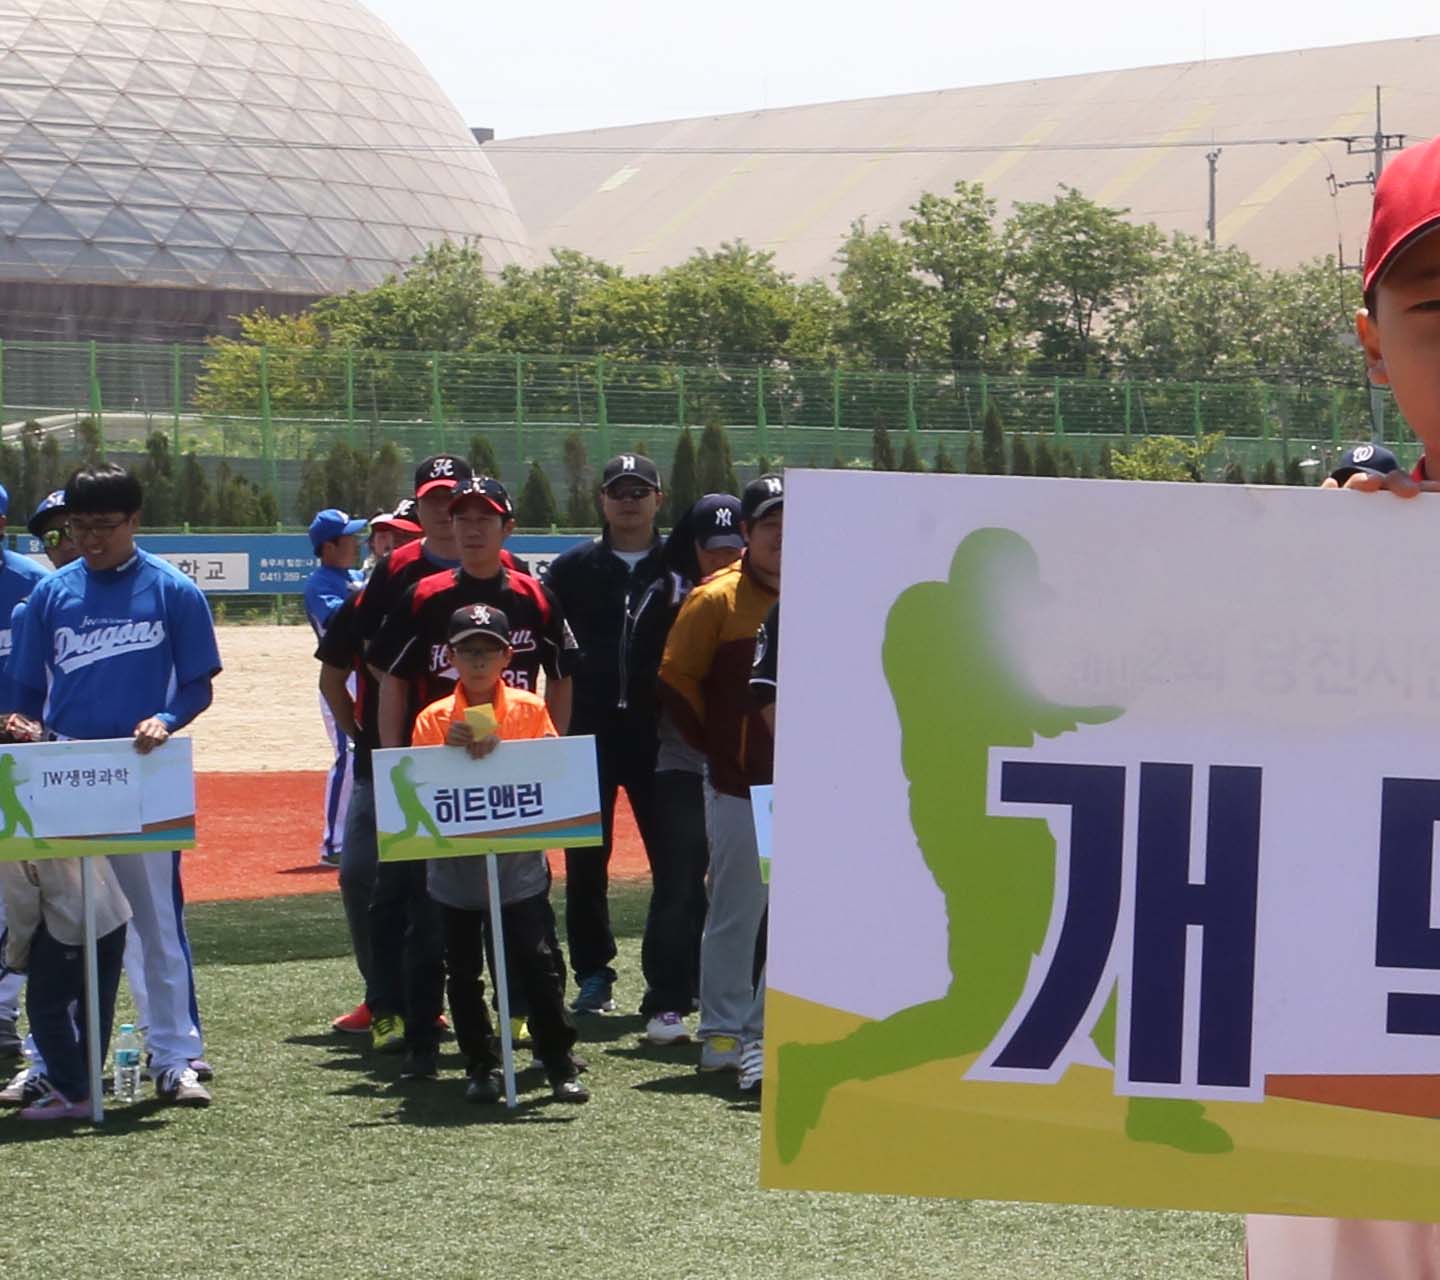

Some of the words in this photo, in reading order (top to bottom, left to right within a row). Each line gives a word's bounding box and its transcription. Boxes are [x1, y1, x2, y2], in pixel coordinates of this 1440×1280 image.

[54, 621, 165, 666] Dragons
[42, 767, 129, 788] JW생명과학
[433, 782, 544, 823] 히트앤런
